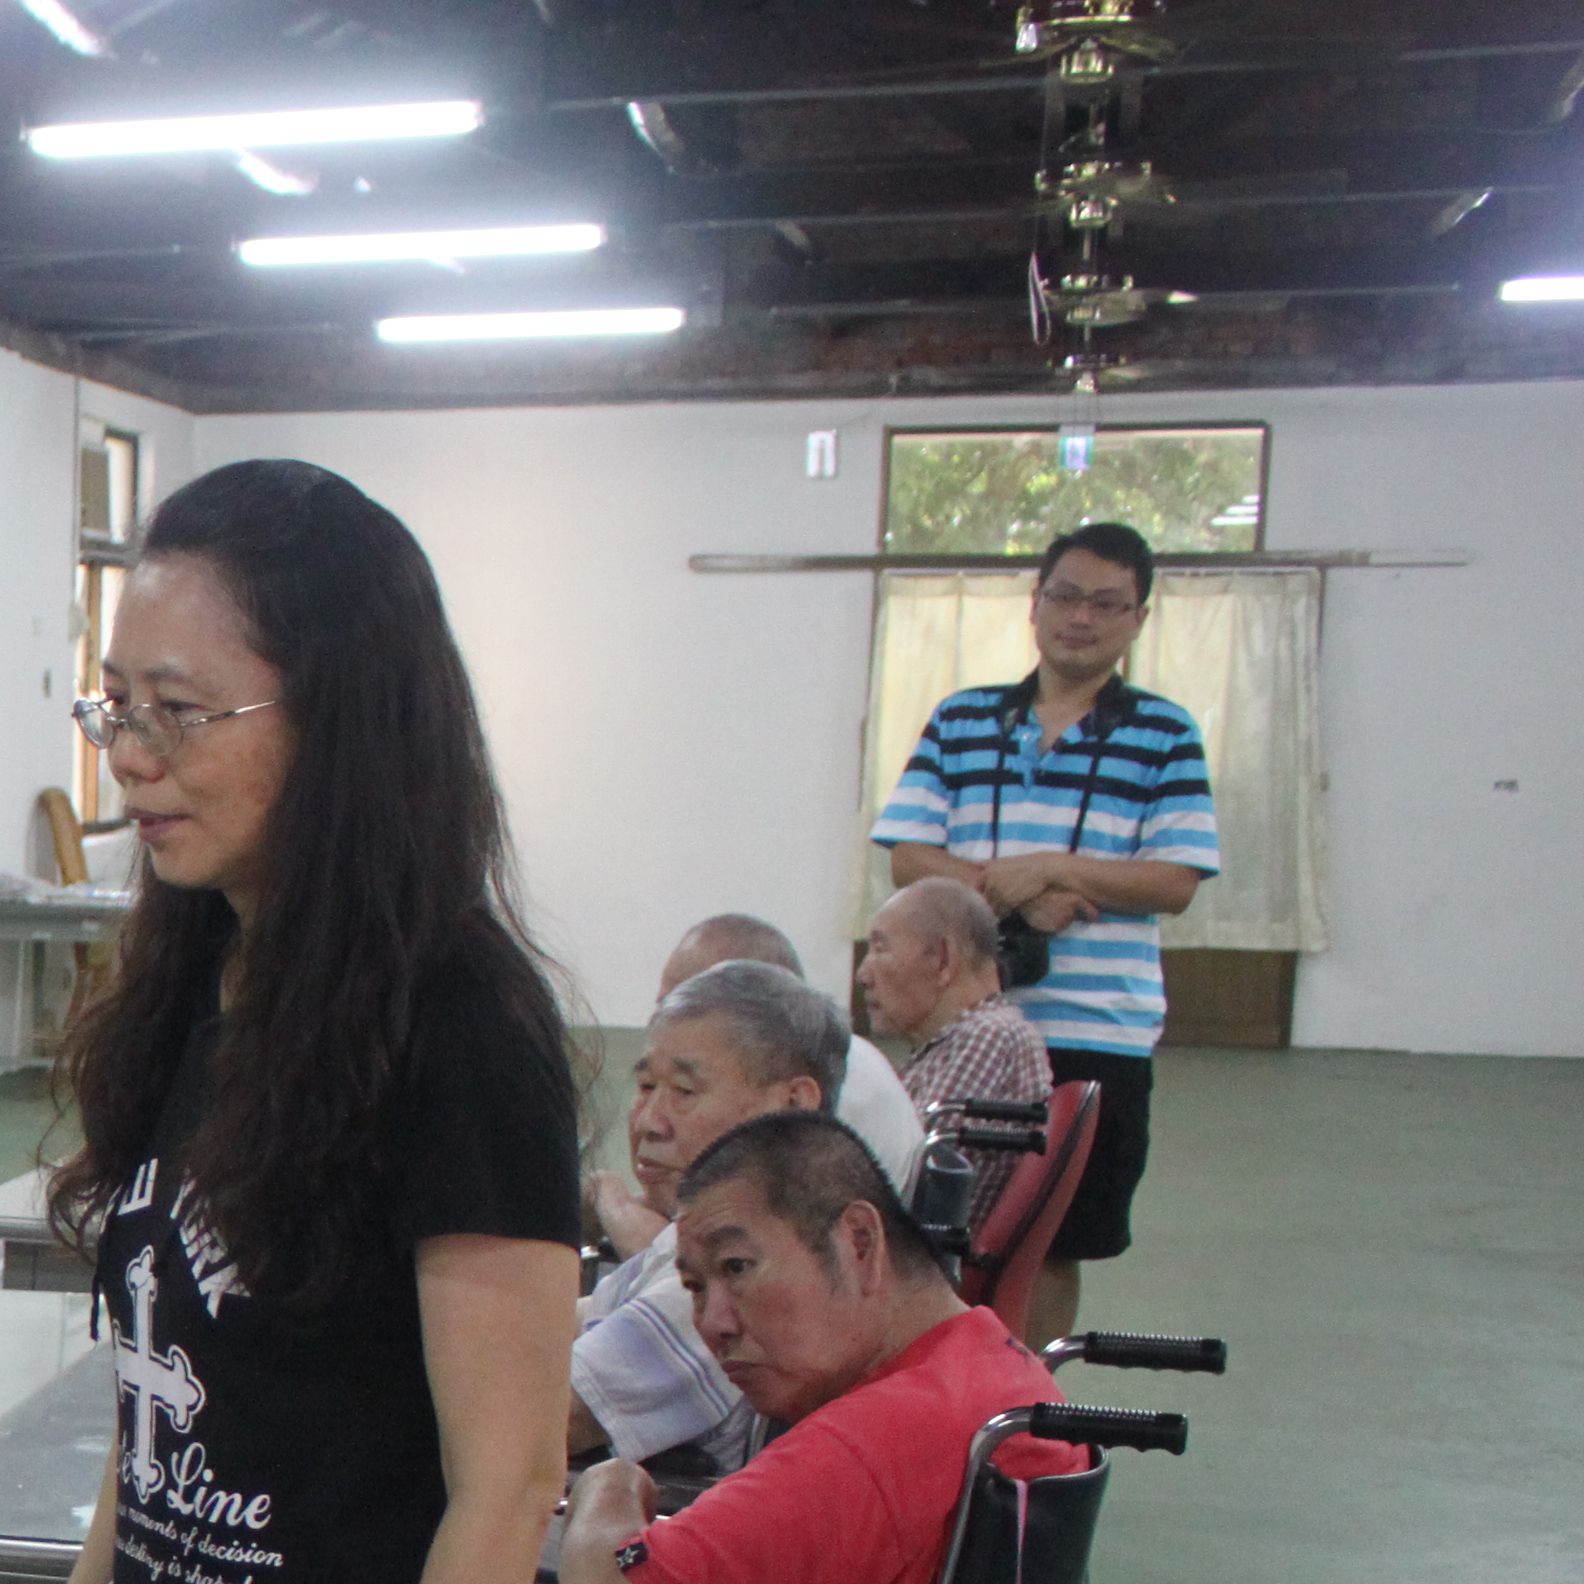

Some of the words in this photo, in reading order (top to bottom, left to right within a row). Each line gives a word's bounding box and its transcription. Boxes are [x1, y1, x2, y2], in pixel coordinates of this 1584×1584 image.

[166, 1442, 272, 1530] Line
[168, 1556, 181, 1577] is
[181, 1526, 198, 1556] of
[198, 1533, 284, 1567] decision
